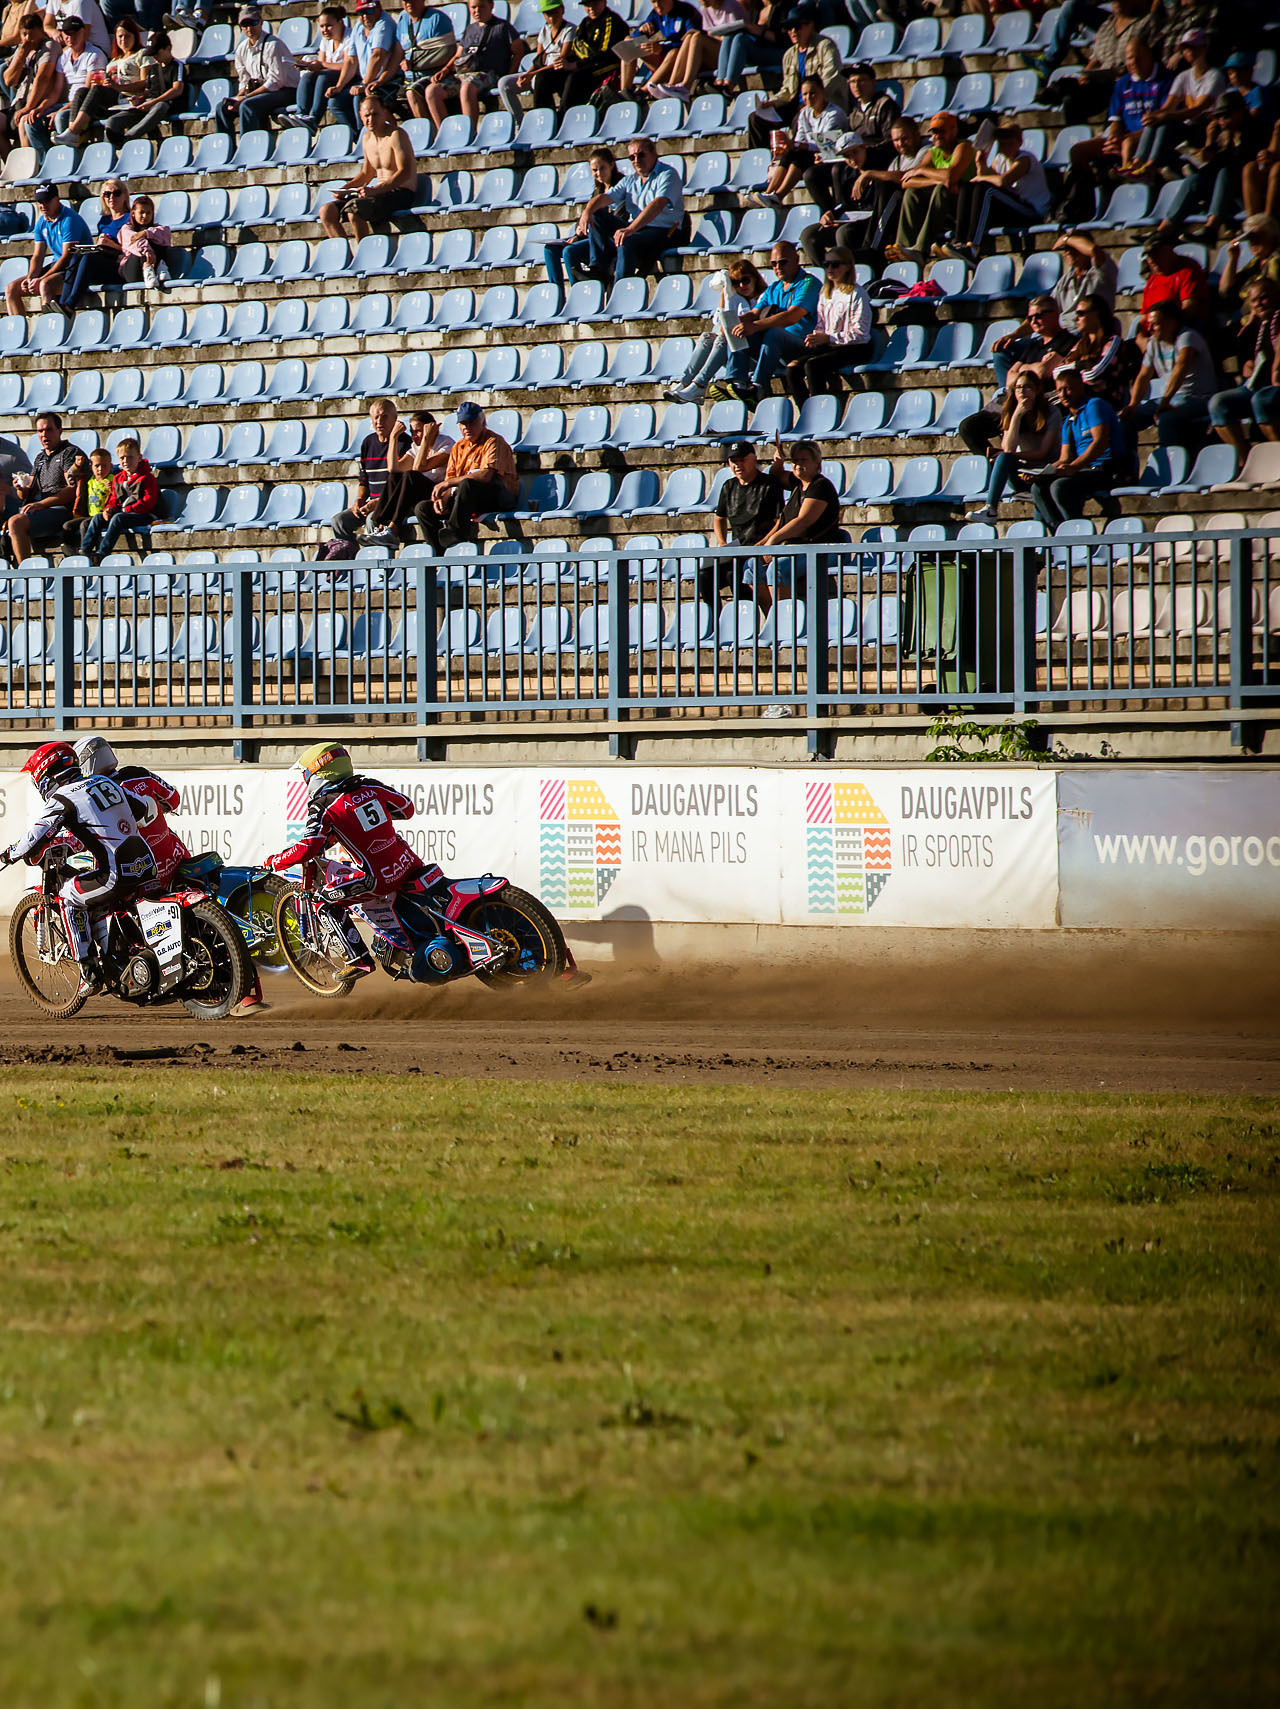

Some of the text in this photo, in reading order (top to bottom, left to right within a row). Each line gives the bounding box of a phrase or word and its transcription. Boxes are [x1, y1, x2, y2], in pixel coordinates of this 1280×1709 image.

[89, 783, 119, 809] 13
[179, 784, 244, 816] AVPILS
[631, 783, 758, 816] DAUGAVPILS
[901, 786, 1033, 819] DAUGAVPILS
[363, 803, 381, 826] 5
[397, 829, 456, 861] PORTS
[632, 830, 747, 864] IR MANA PILS
[902, 834, 993, 868] IR SPORTS
